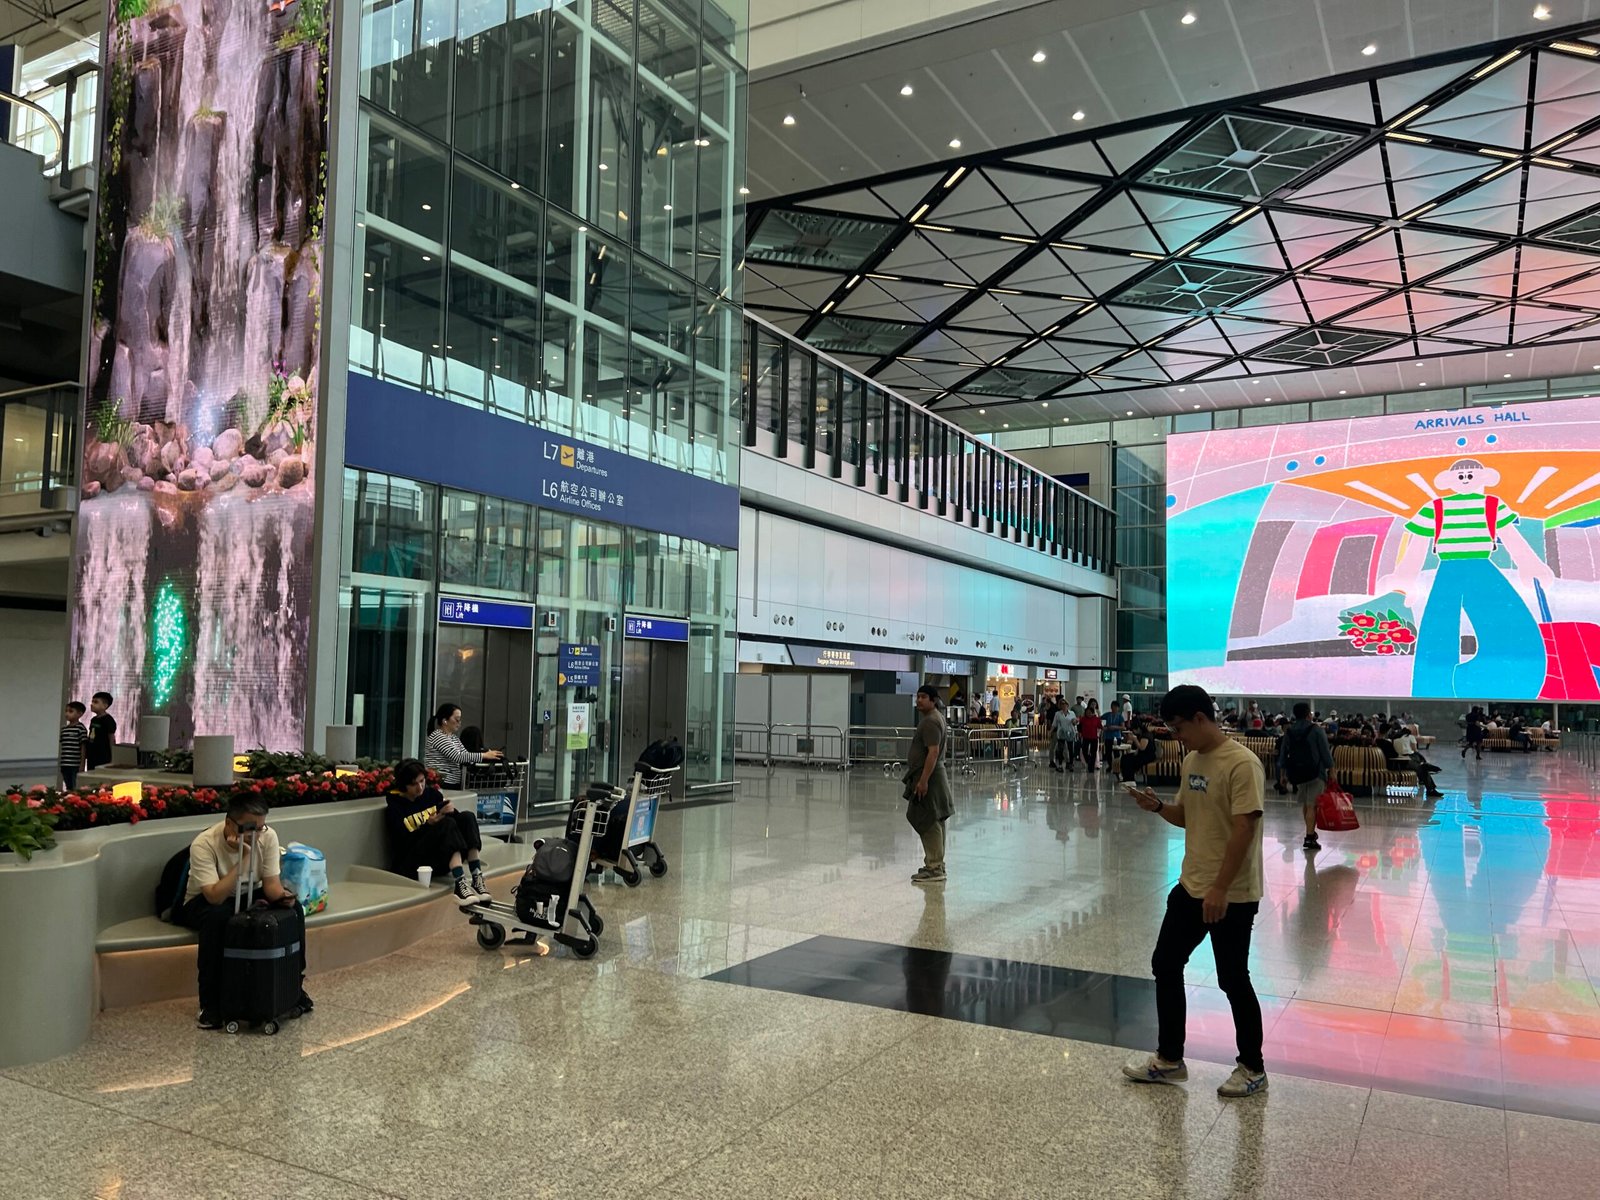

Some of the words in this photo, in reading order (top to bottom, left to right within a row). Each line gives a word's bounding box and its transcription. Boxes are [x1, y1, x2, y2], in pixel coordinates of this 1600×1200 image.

[1414, 414, 1485, 430] ARRIVALS
[1494, 411, 1531, 422] HALL
[543, 441, 559, 461] L7
[577, 447, 595, 463] 離港
[576, 460, 608, 477] Departures
[542, 479, 558, 498] L6
[560, 480, 624, 507] 航空公司辦公室
[560, 494, 580, 507] Airline
[581, 499, 602, 511] Offices
[455, 602, 479, 613] 升降機
[568, 647, 574, 655] L7
